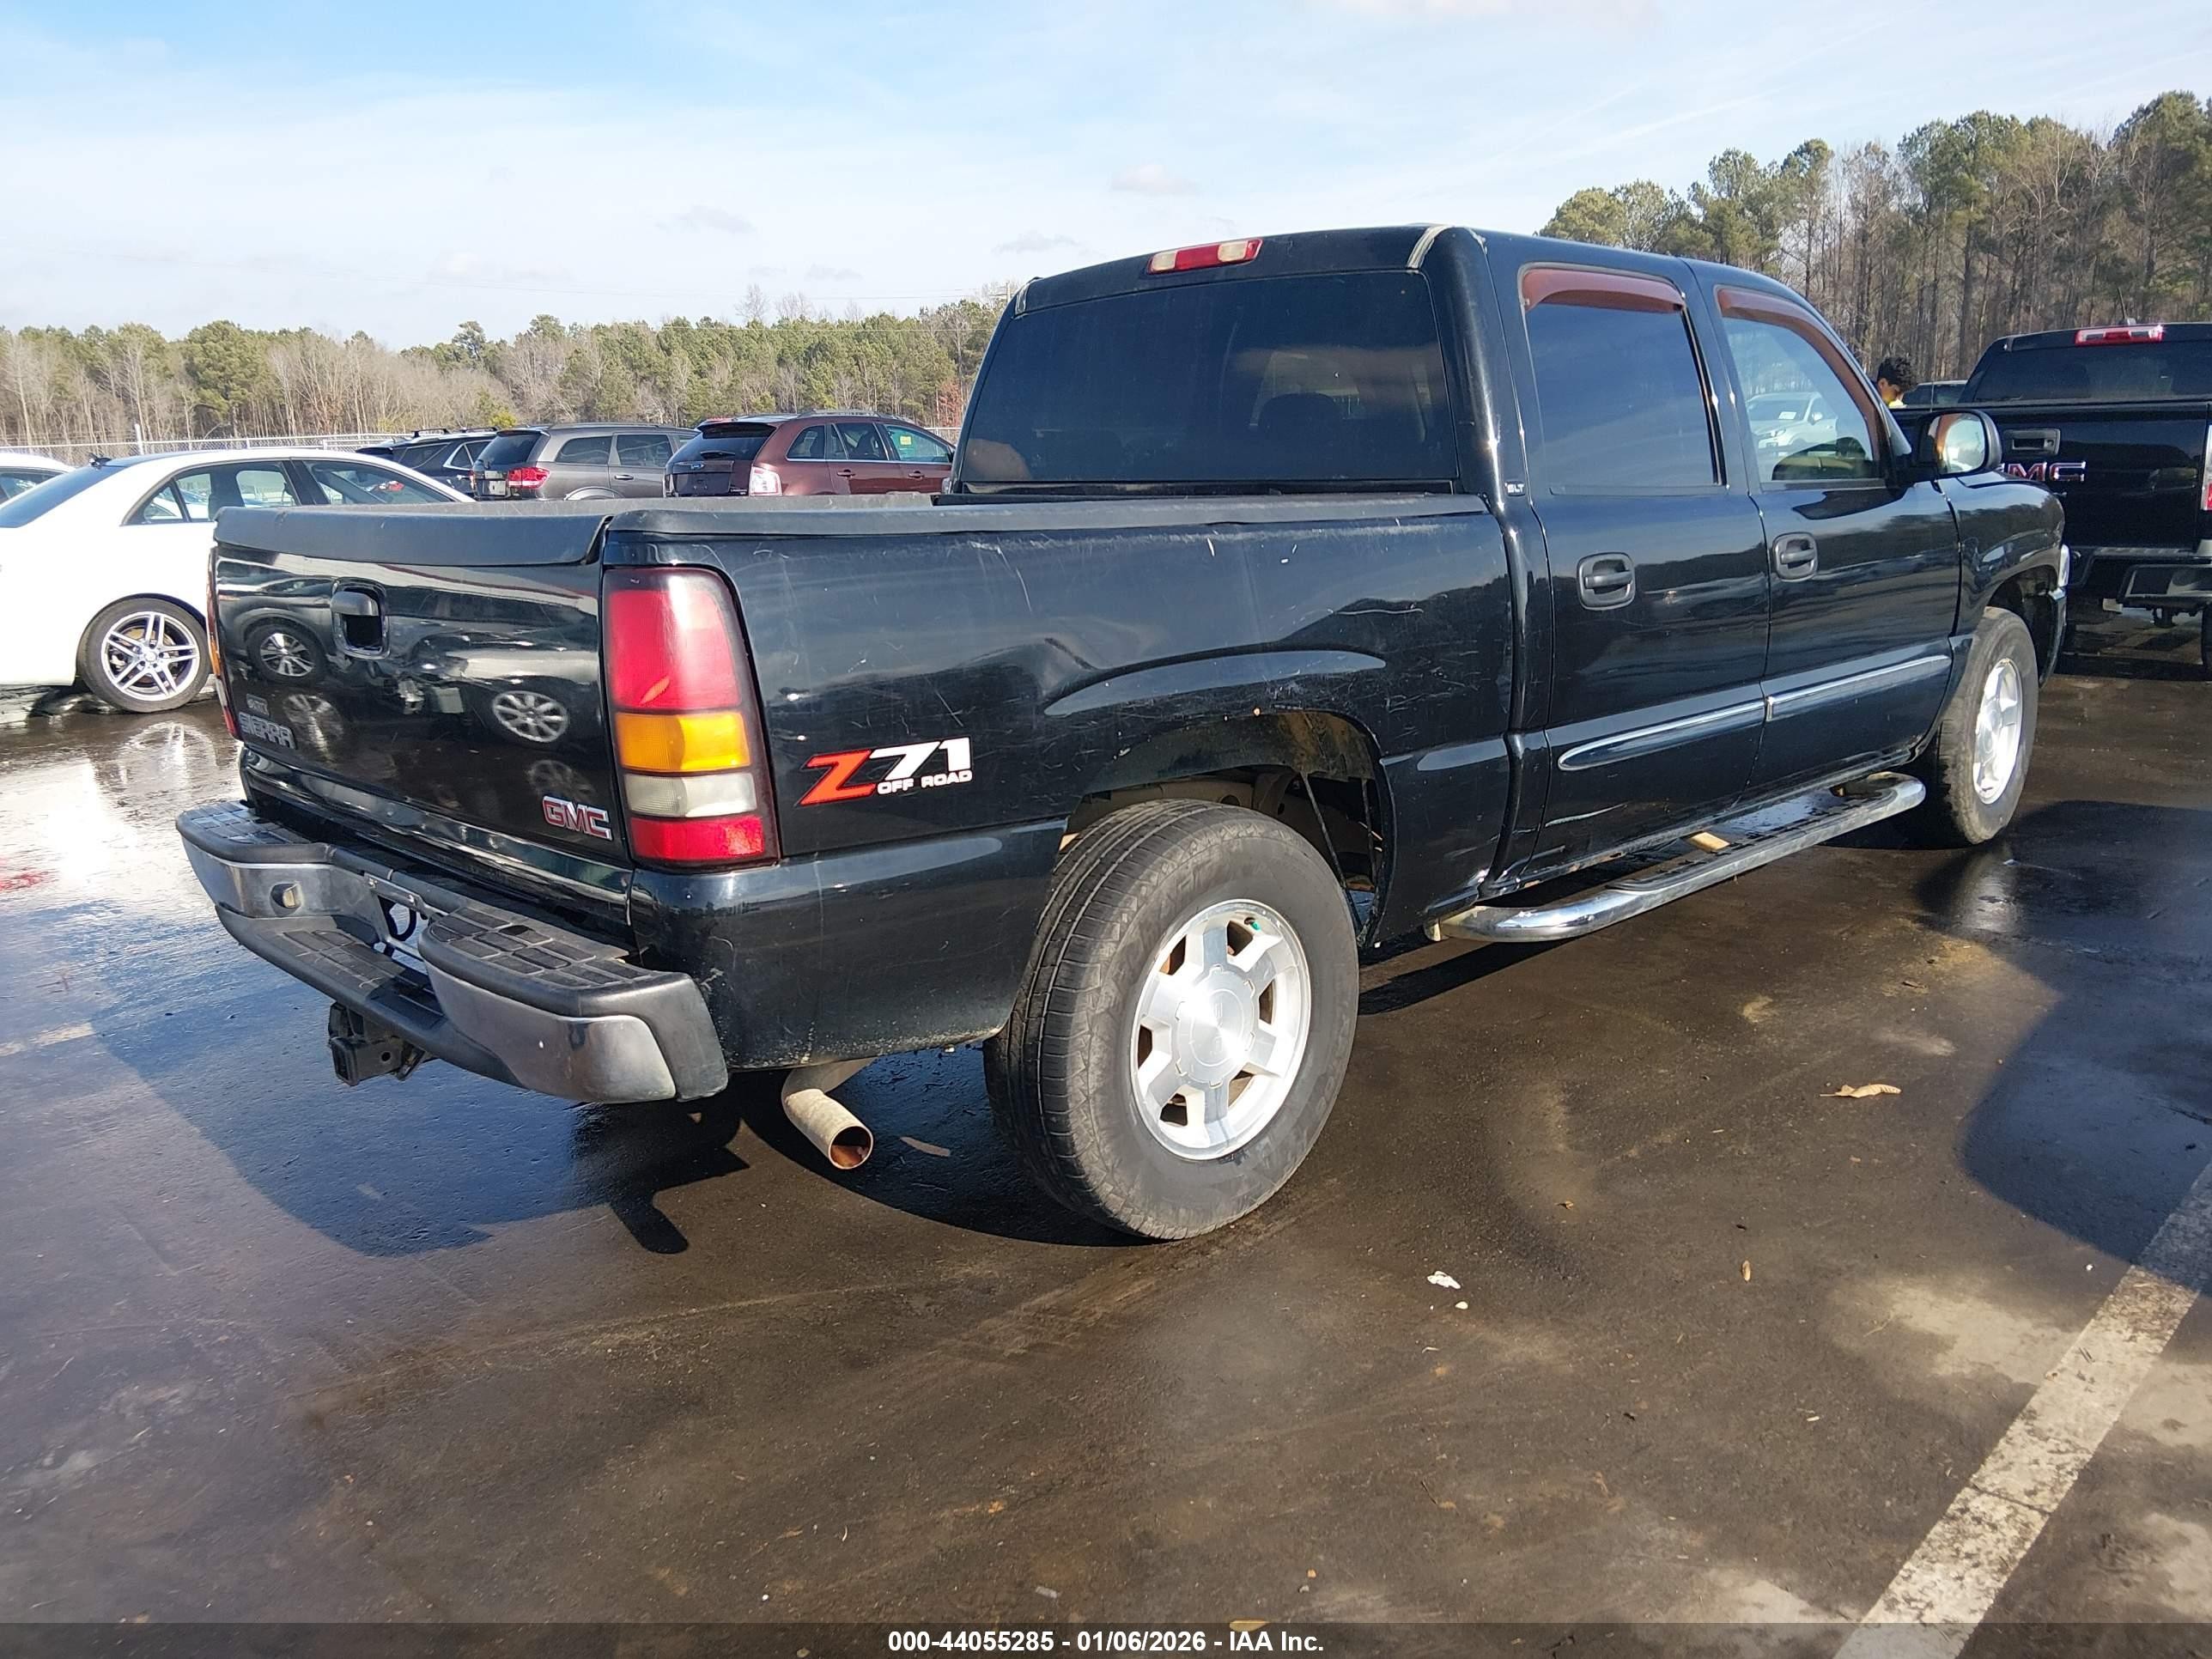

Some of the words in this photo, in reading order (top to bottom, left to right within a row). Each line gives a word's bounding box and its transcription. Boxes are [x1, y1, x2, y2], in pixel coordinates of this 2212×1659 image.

[239, 712, 296, 750] SIERRA
[799, 736, 972, 806] Z71
[878, 778, 915, 795] OFF
[921, 769, 973, 789] ROAD
[543, 795, 613, 841] GMC
